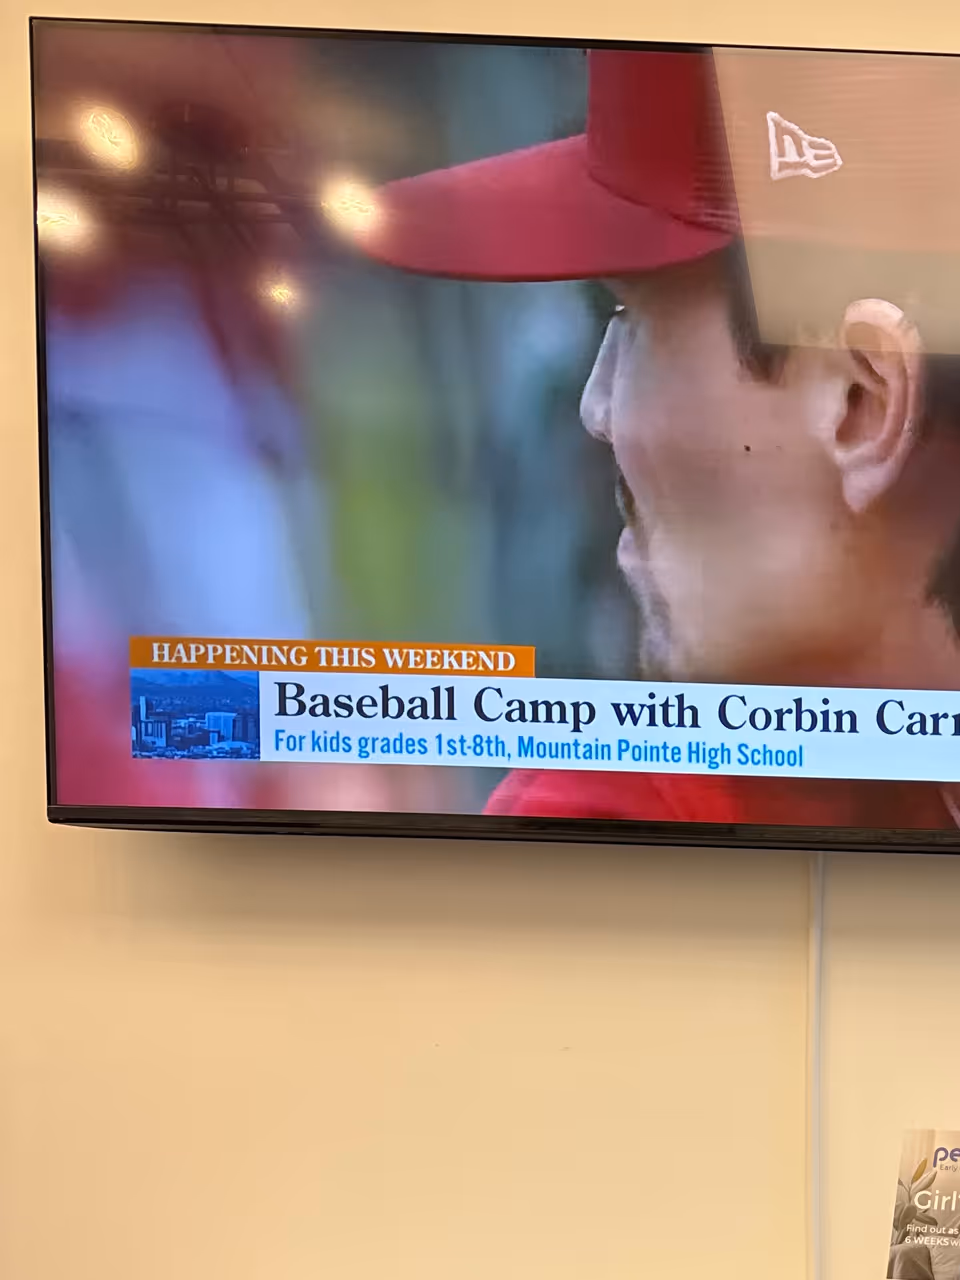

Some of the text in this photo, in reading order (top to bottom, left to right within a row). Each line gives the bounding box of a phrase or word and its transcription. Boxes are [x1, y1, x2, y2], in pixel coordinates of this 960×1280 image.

[152, 642, 516, 672] HAPPENING THIS WEEKEND
[274, 681, 458, 721] Baseball
[474, 686, 596, 733] Camp
[610, 691, 702, 729] with
[718, 694, 860, 734] Corbin
[274, 729, 803, 770] For kids grades 1st-8th, Mountain Pointe High School
[939, 1164, 958, 1173] Early
[906, 1223, 928, 1233] Find
[929, 1226, 946, 1235] out
[947, 1228, 959, 1236] as
[904, 1235, 912, 1244] 6
[914, 1235, 950, 1247] WEEKS
